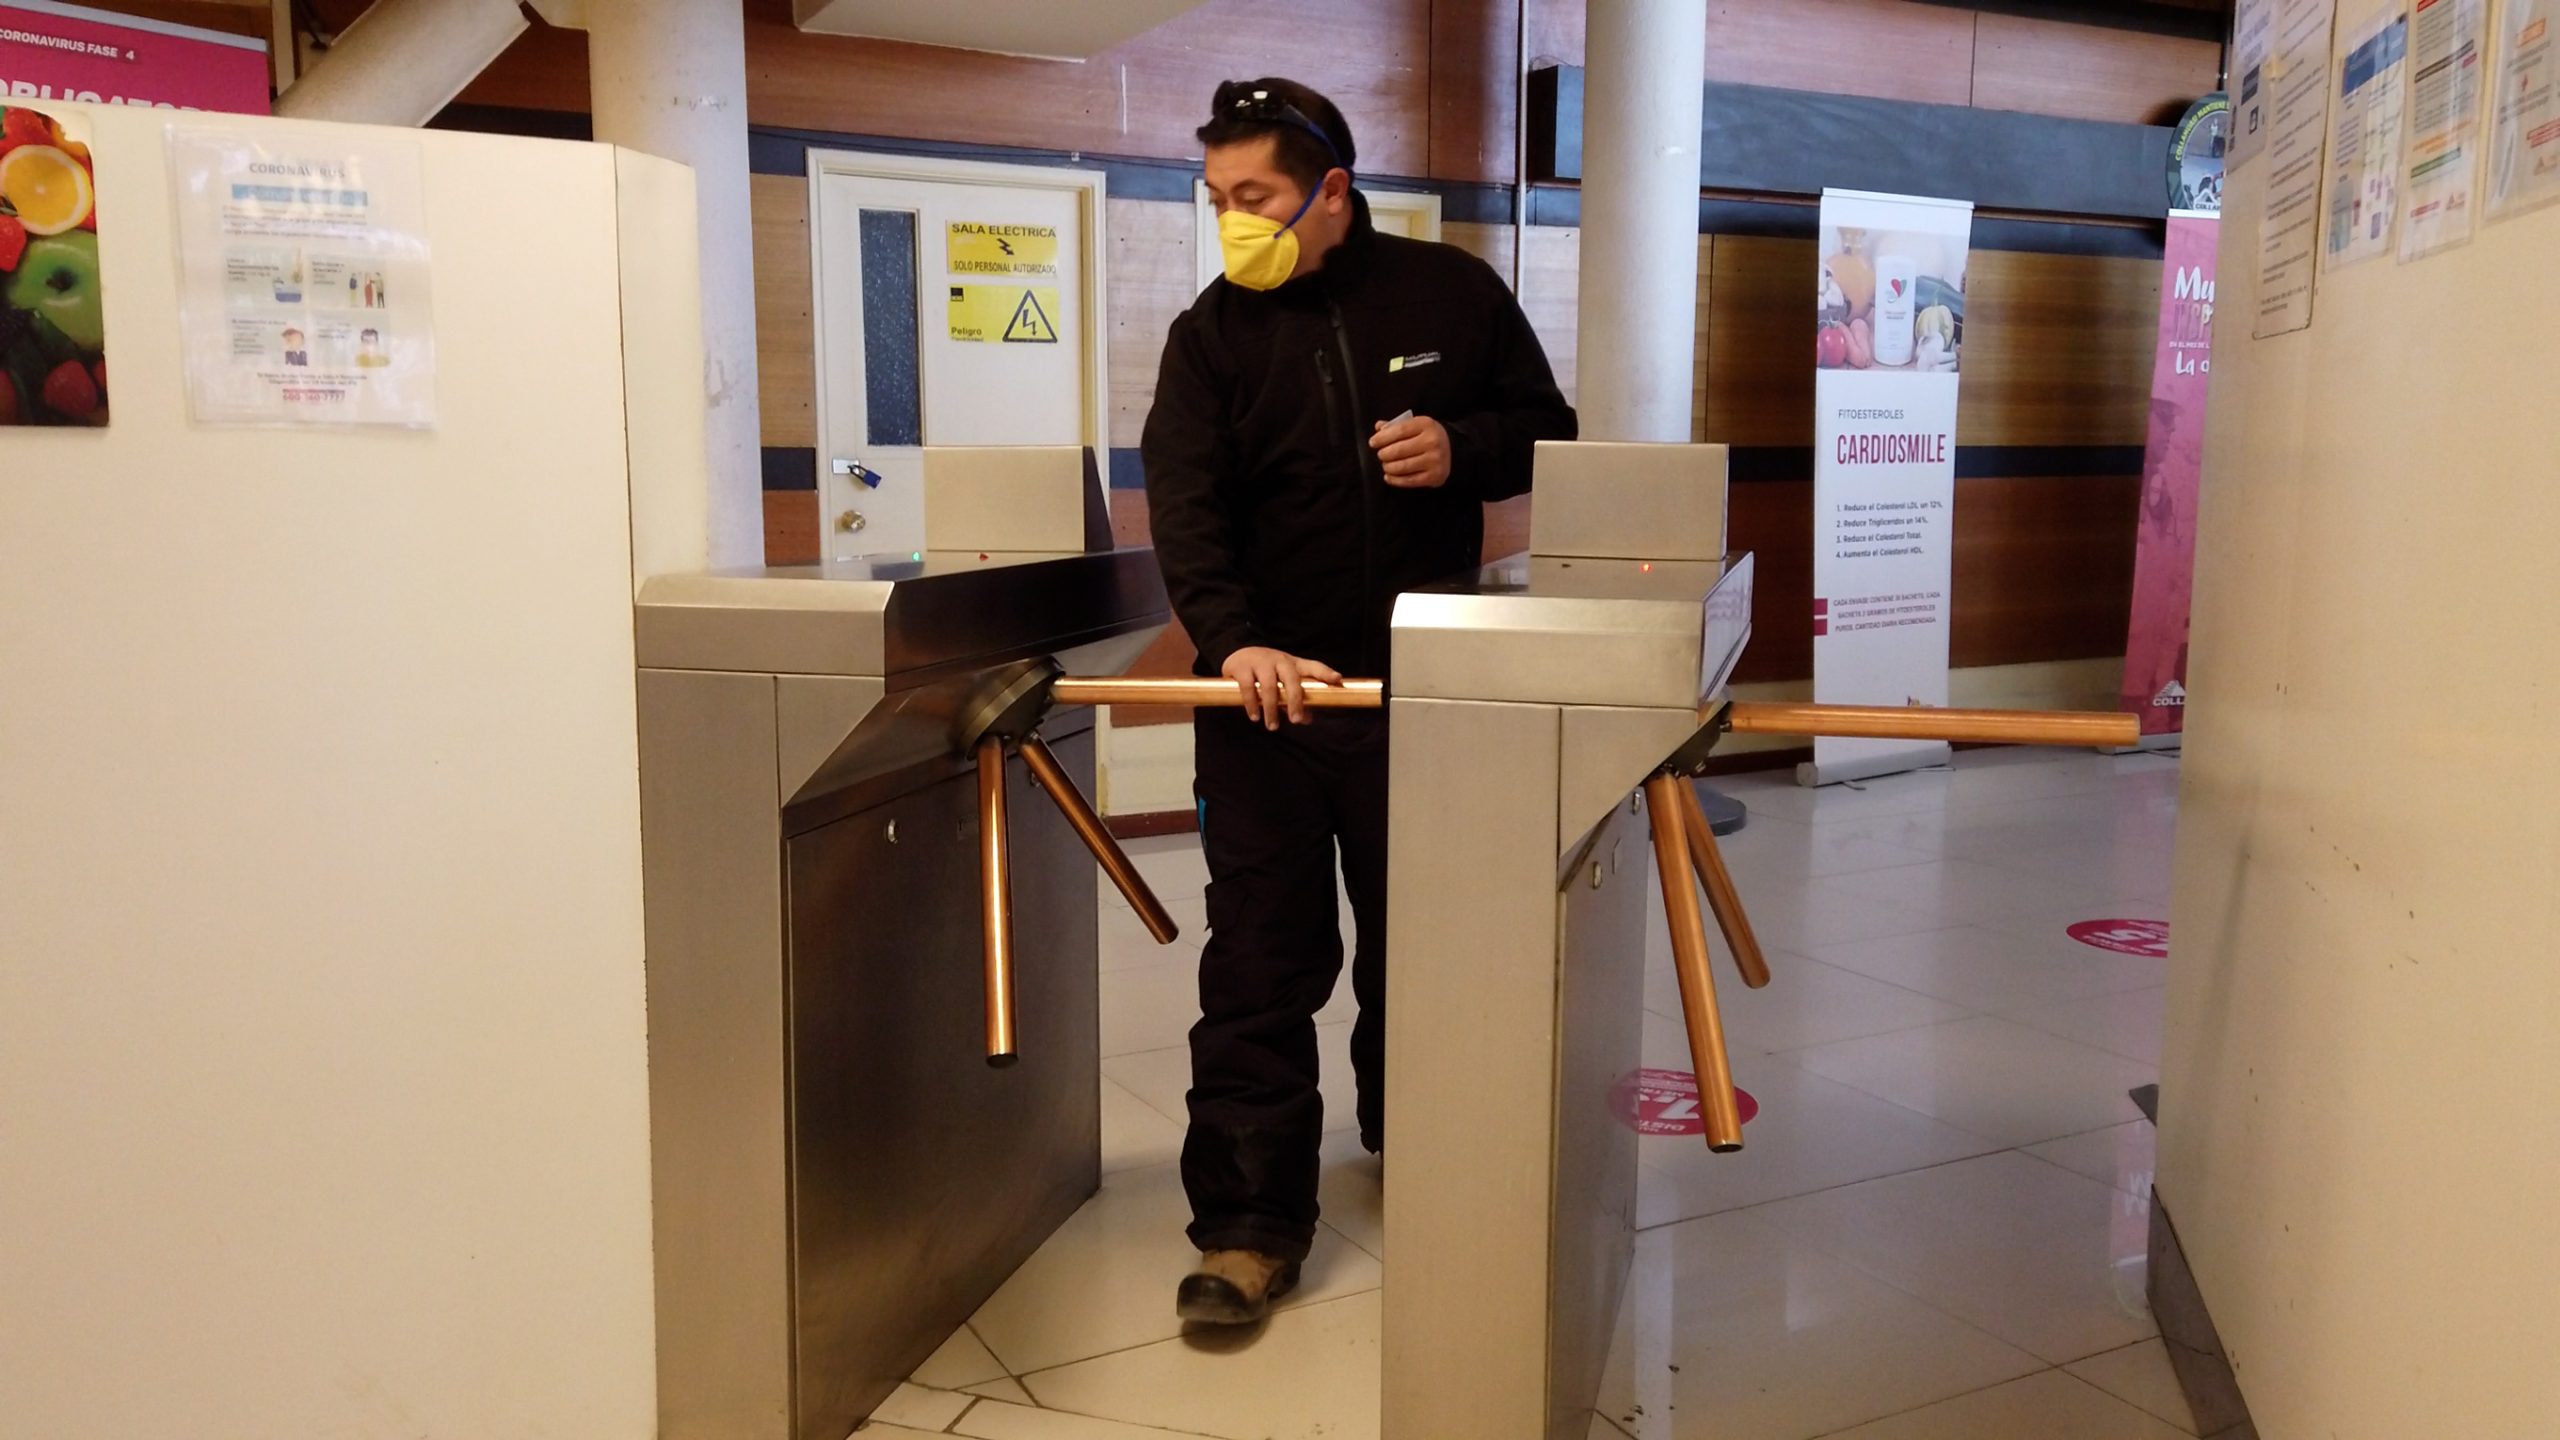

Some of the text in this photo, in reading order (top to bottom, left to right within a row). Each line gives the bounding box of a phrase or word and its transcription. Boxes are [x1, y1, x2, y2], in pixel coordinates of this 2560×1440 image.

[87, 43, 118, 58] FASE
[126, 50, 135, 60] 4
[952, 223, 1056, 238] SALA ELECTRICA
[954, 260, 1057, 274] SOLO PERSONAL AUTORIZADO
[951, 327, 982, 337] Peligro
[1838, 409, 1905, 420] FITOESTEROLES
[1837, 433, 1946, 464] CARDIOSMILE
[1844, 503, 1867, 511] Reduce
[1844, 519, 1867, 528] Reduce
[1844, 535, 1866, 543] Reduce
[1844, 550, 1871, 558] Aumenta
